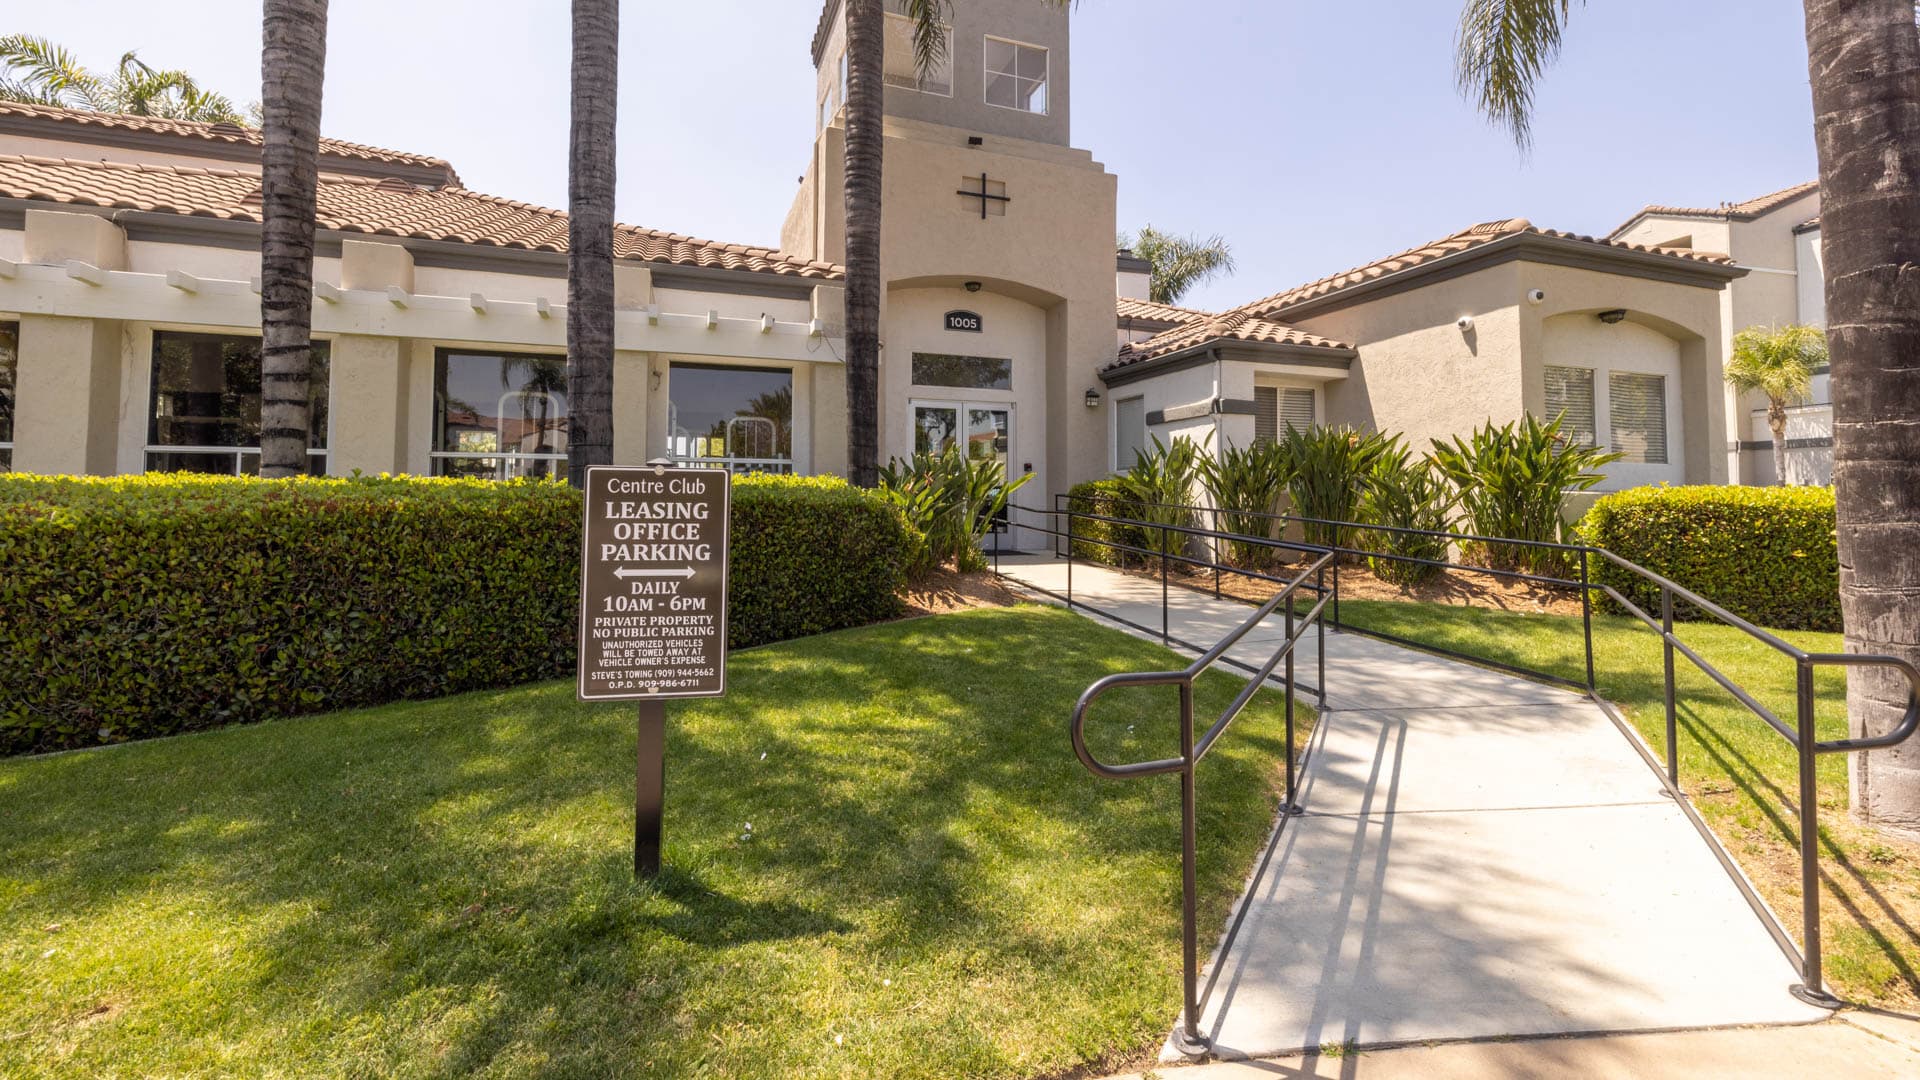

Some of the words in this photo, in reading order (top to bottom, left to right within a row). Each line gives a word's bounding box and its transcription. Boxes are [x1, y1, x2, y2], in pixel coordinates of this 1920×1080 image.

[950, 317, 977, 329] 1005
[607, 478, 663, 493] Centre
[669, 477, 705, 494] Club
[605, 501, 709, 519] LEASING
[614, 523, 700, 540] OFFICE
[601, 544, 711, 561] PARKING
[631, 582, 680, 594] DAILY
[603, 596, 653, 612] 10AM
[670, 595, 706, 610] 6PM
[595, 616, 647, 627] PRIVATE
[650, 616, 713, 626] PROPERTY
[593, 628, 610, 638] NO
[614, 627, 658, 638] PUBLIC
[662, 626, 715, 636] PARKING
[602, 640, 663, 649] UNAUTHORIZED
[666, 639, 703, 647] VEHICLES
[603, 650, 621, 658] WILL
[625, 649, 635, 657] BE
[638, 649, 663, 657] TOWED
[666, 648, 688, 656] AWAY
[599, 658, 632, 667] VEHICLE
[635, 657, 668, 666] OWNER'S
[671, 656, 706, 665] EXPENSE
[591, 671, 622, 680] STEVE'S
[625, 670, 652, 679] TOWING
[654, 669, 675, 678] (909)
[677, 668, 714, 677] 944-5662
[609, 681, 635, 689] O.P.D.
[638, 679, 699, 689] 909-986-6711
